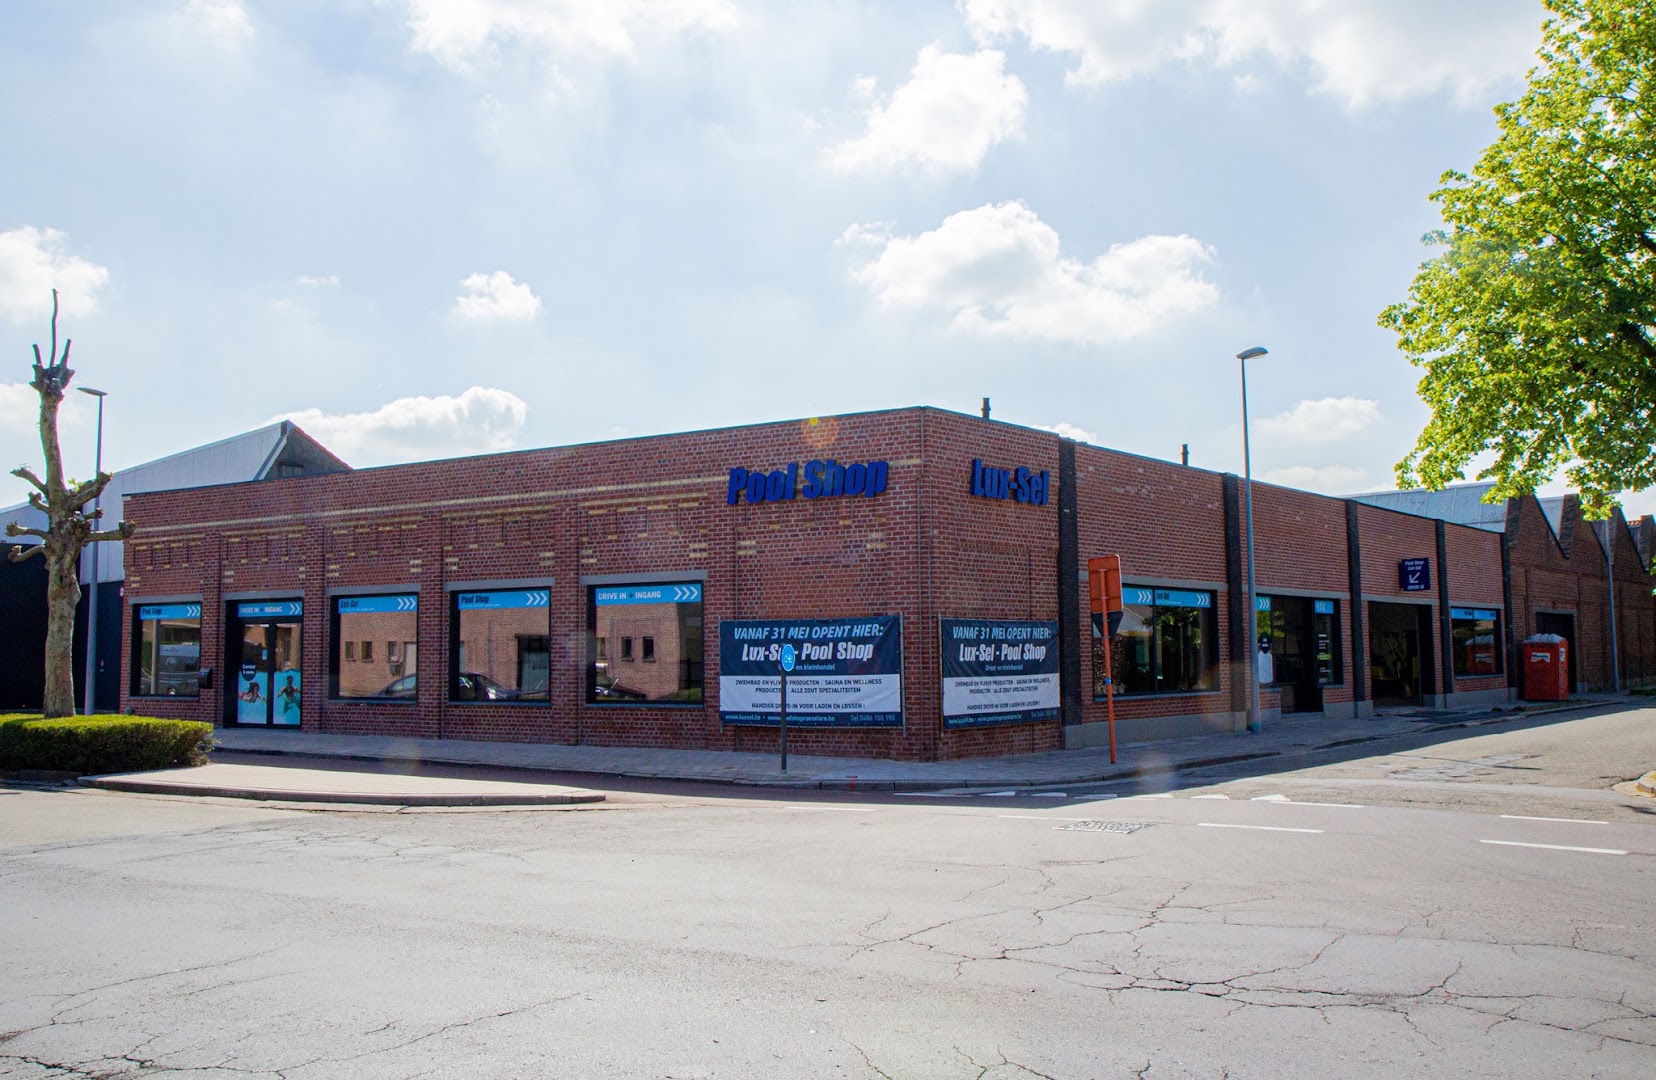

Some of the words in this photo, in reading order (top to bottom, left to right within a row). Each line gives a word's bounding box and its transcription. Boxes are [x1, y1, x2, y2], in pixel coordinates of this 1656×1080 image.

[727, 462, 798, 505] Pool
[802, 459, 889, 498] Shop
[970, 458, 1049, 505] Lux-Sel
[461, 596, 474, 604] Pool
[474, 594, 490, 604] Shop
[635, 590, 662, 598] INGANG
[734, 627, 770, 640] VANAF
[771, 627, 786, 640] 31
[787, 626, 810, 639] MEI
[812, 626, 851, 638] OPENT
[852, 624, 884, 638] HIER:
[953, 626, 979, 638] VANAF
[980, 628, 990, 639] 31
[992, 628, 1006, 639] MEI
[1006, 628, 1032, 639] OPENT
[1032, 628, 1052, 638] HIER:
[742, 643, 791, 662] Lux-S
[801, 642, 834, 660] Pool
[836, 642, 874, 662] Shop
[959, 643, 995, 662] Lux-Sel
[1001, 643, 1022, 660] Pool
[1023, 643, 1046, 662] Shop
